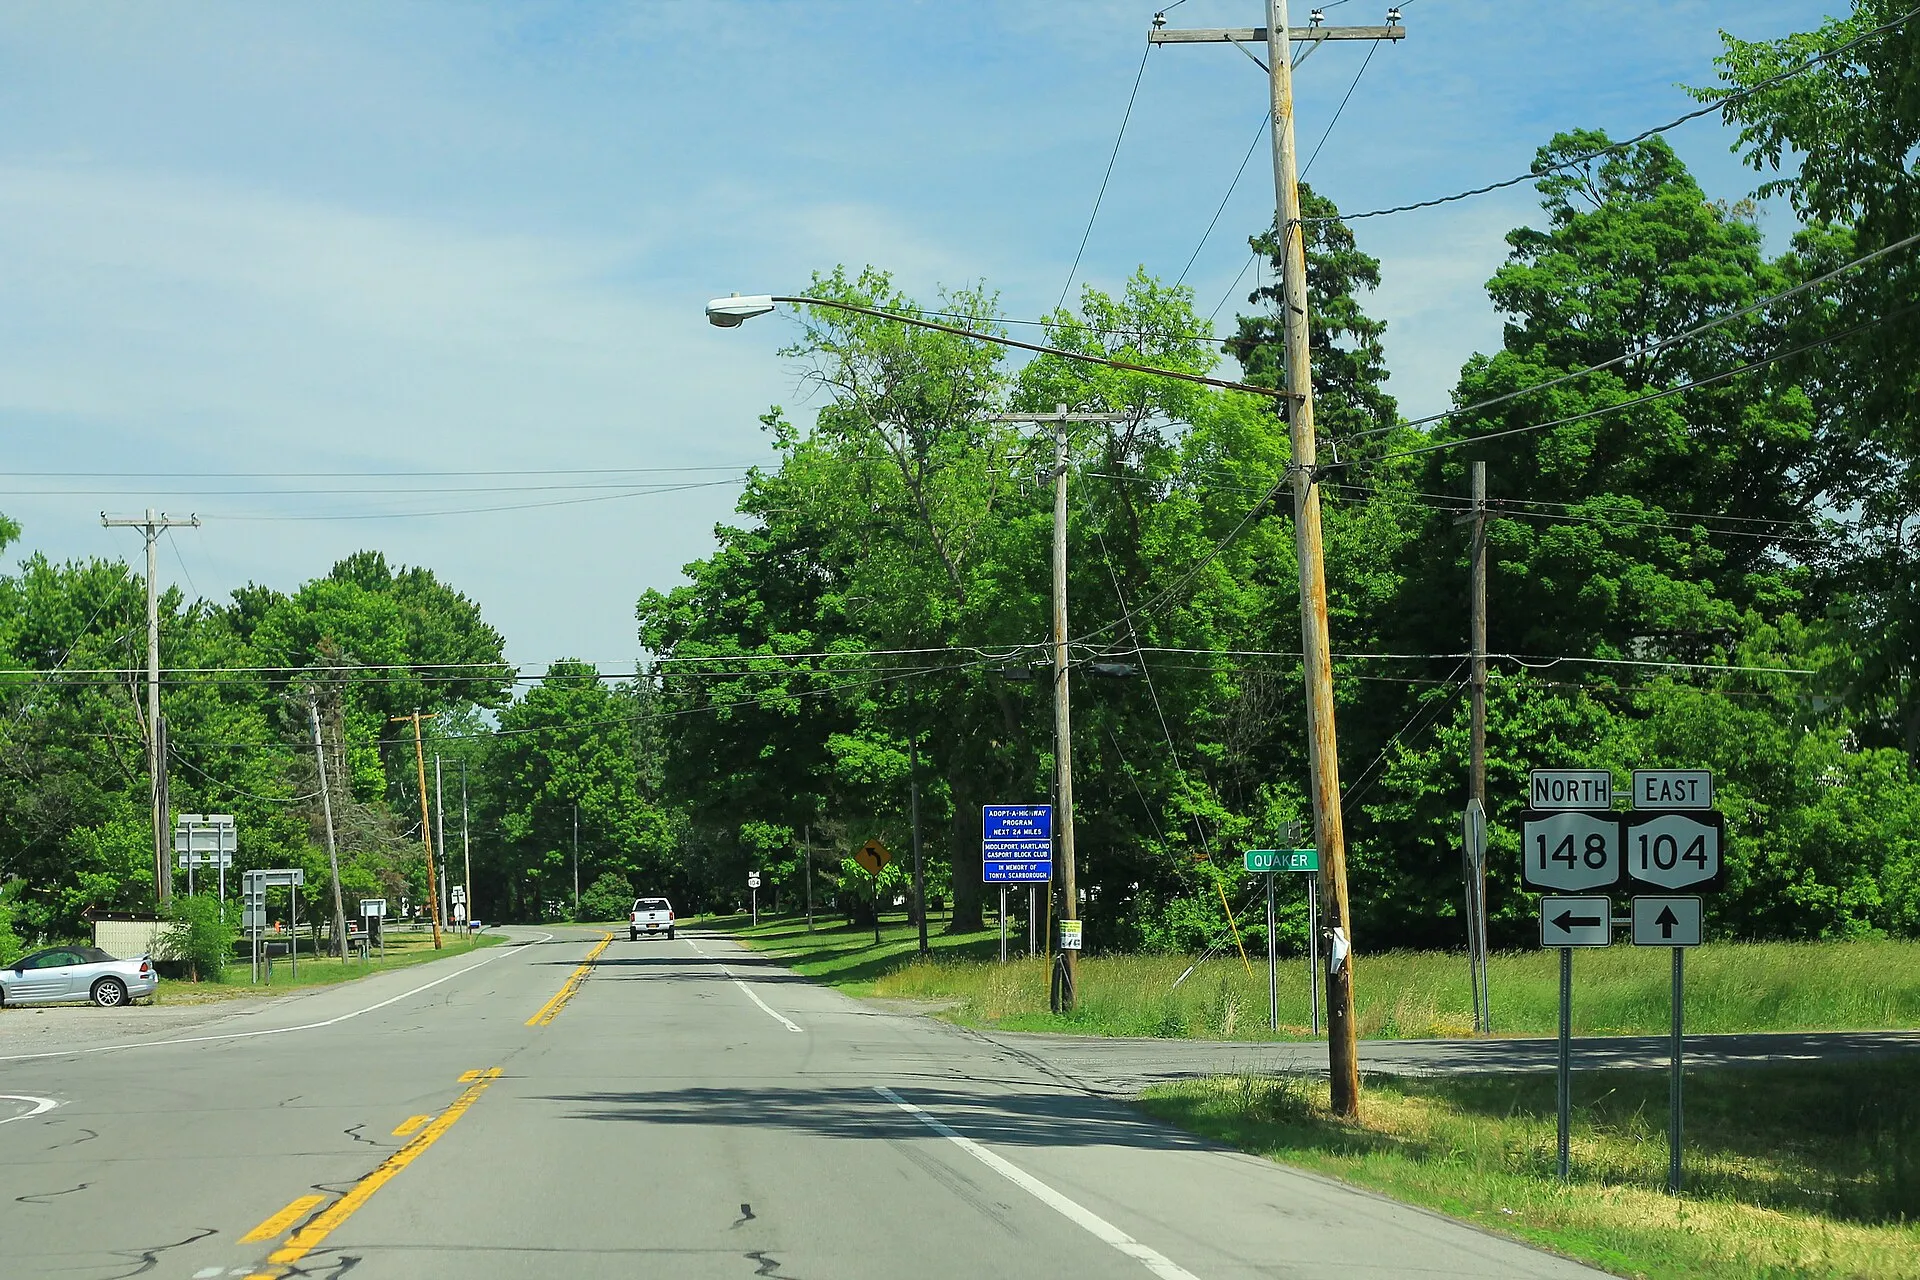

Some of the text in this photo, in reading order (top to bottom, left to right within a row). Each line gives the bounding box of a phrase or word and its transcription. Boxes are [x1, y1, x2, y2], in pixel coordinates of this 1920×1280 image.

[1535, 778, 1607, 802] NORTH
[1645, 778, 1698, 802] EAST
[1254, 854, 1308, 867] QUAKER
[1536, 833, 1608, 870] 148
[1638, 833, 1708, 870] 104
